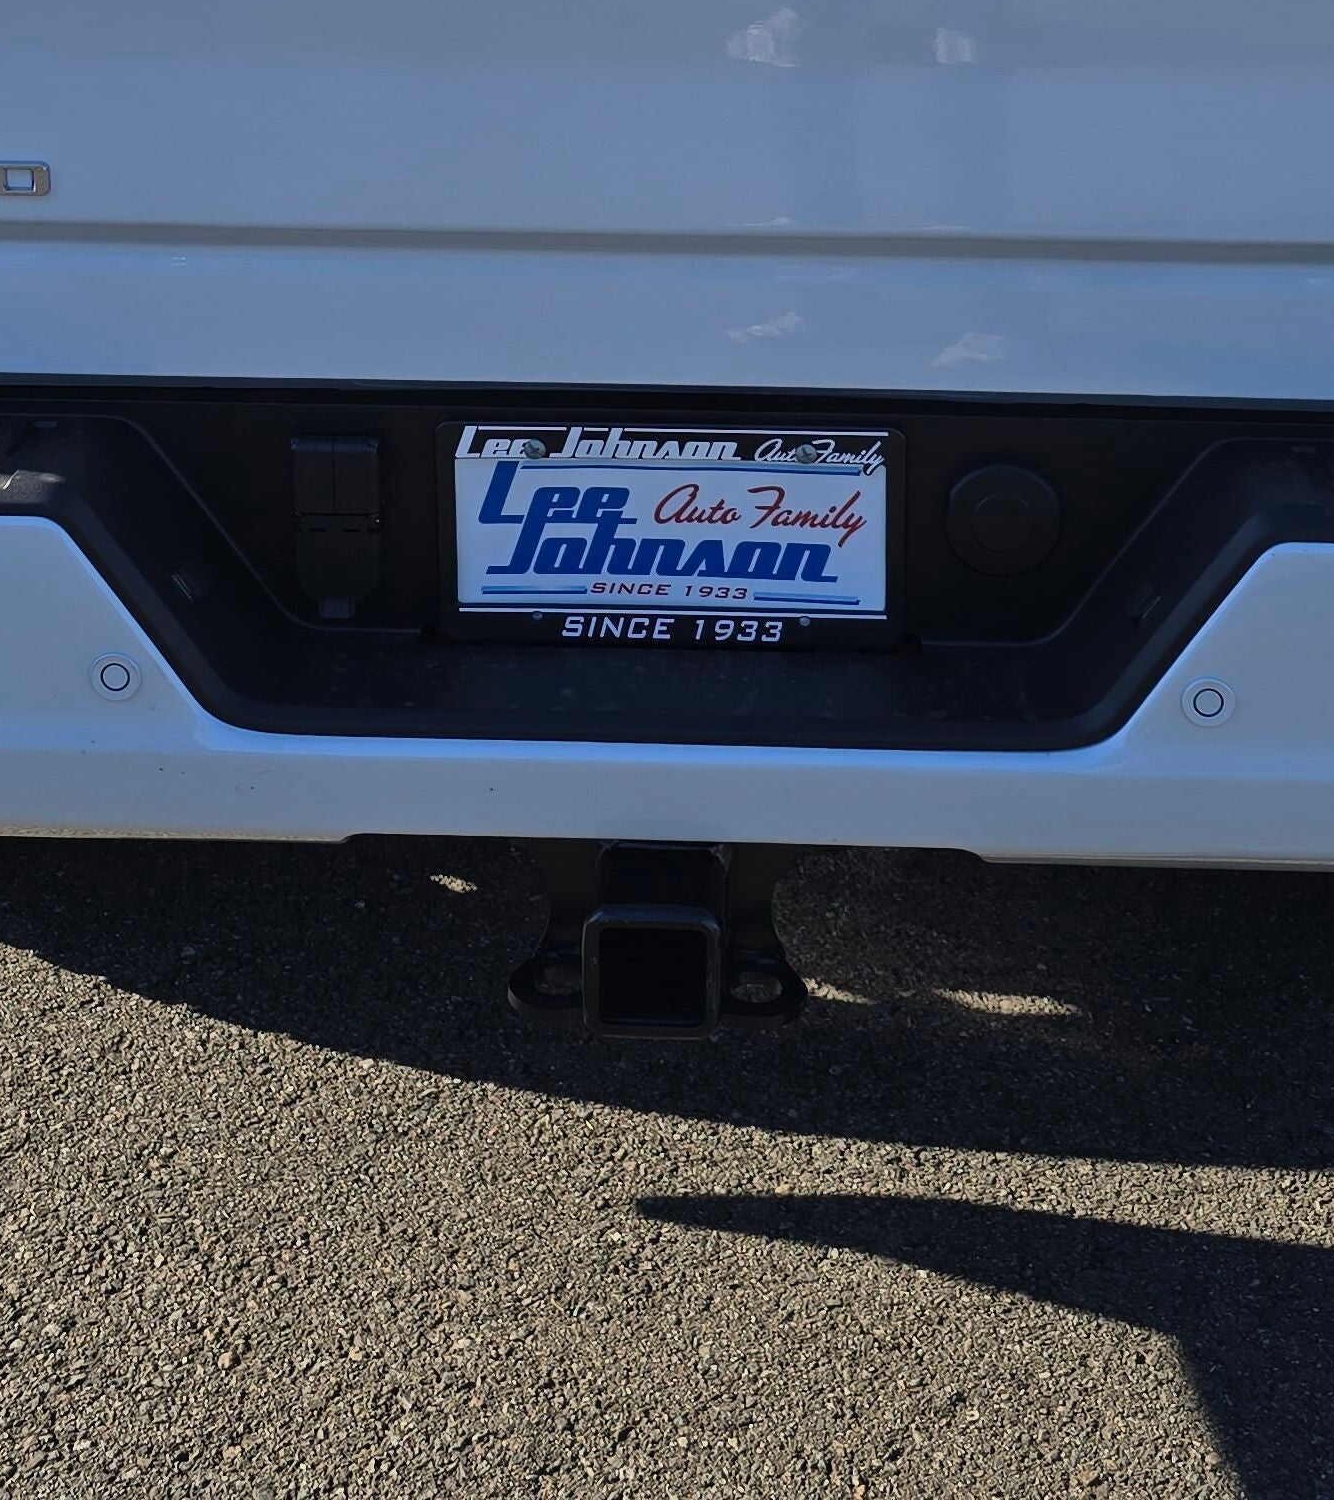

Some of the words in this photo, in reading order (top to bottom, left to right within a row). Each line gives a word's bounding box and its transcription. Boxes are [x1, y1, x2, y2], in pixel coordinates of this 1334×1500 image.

[548, 426, 742, 461] Johnson
[753, 438, 801, 462] Aut
[811, 438, 885, 475] Family
[477, 460, 638, 525] Lee
[653, 483, 743, 526] Auto
[747, 484, 867, 548] Family
[485, 514, 839, 584] Johnson
[590, 582, 672, 596] SINCE
[684, 584, 749, 600] 1933
[561, 615, 672, 641] SINCE
[693, 619, 784, 643] 1933
